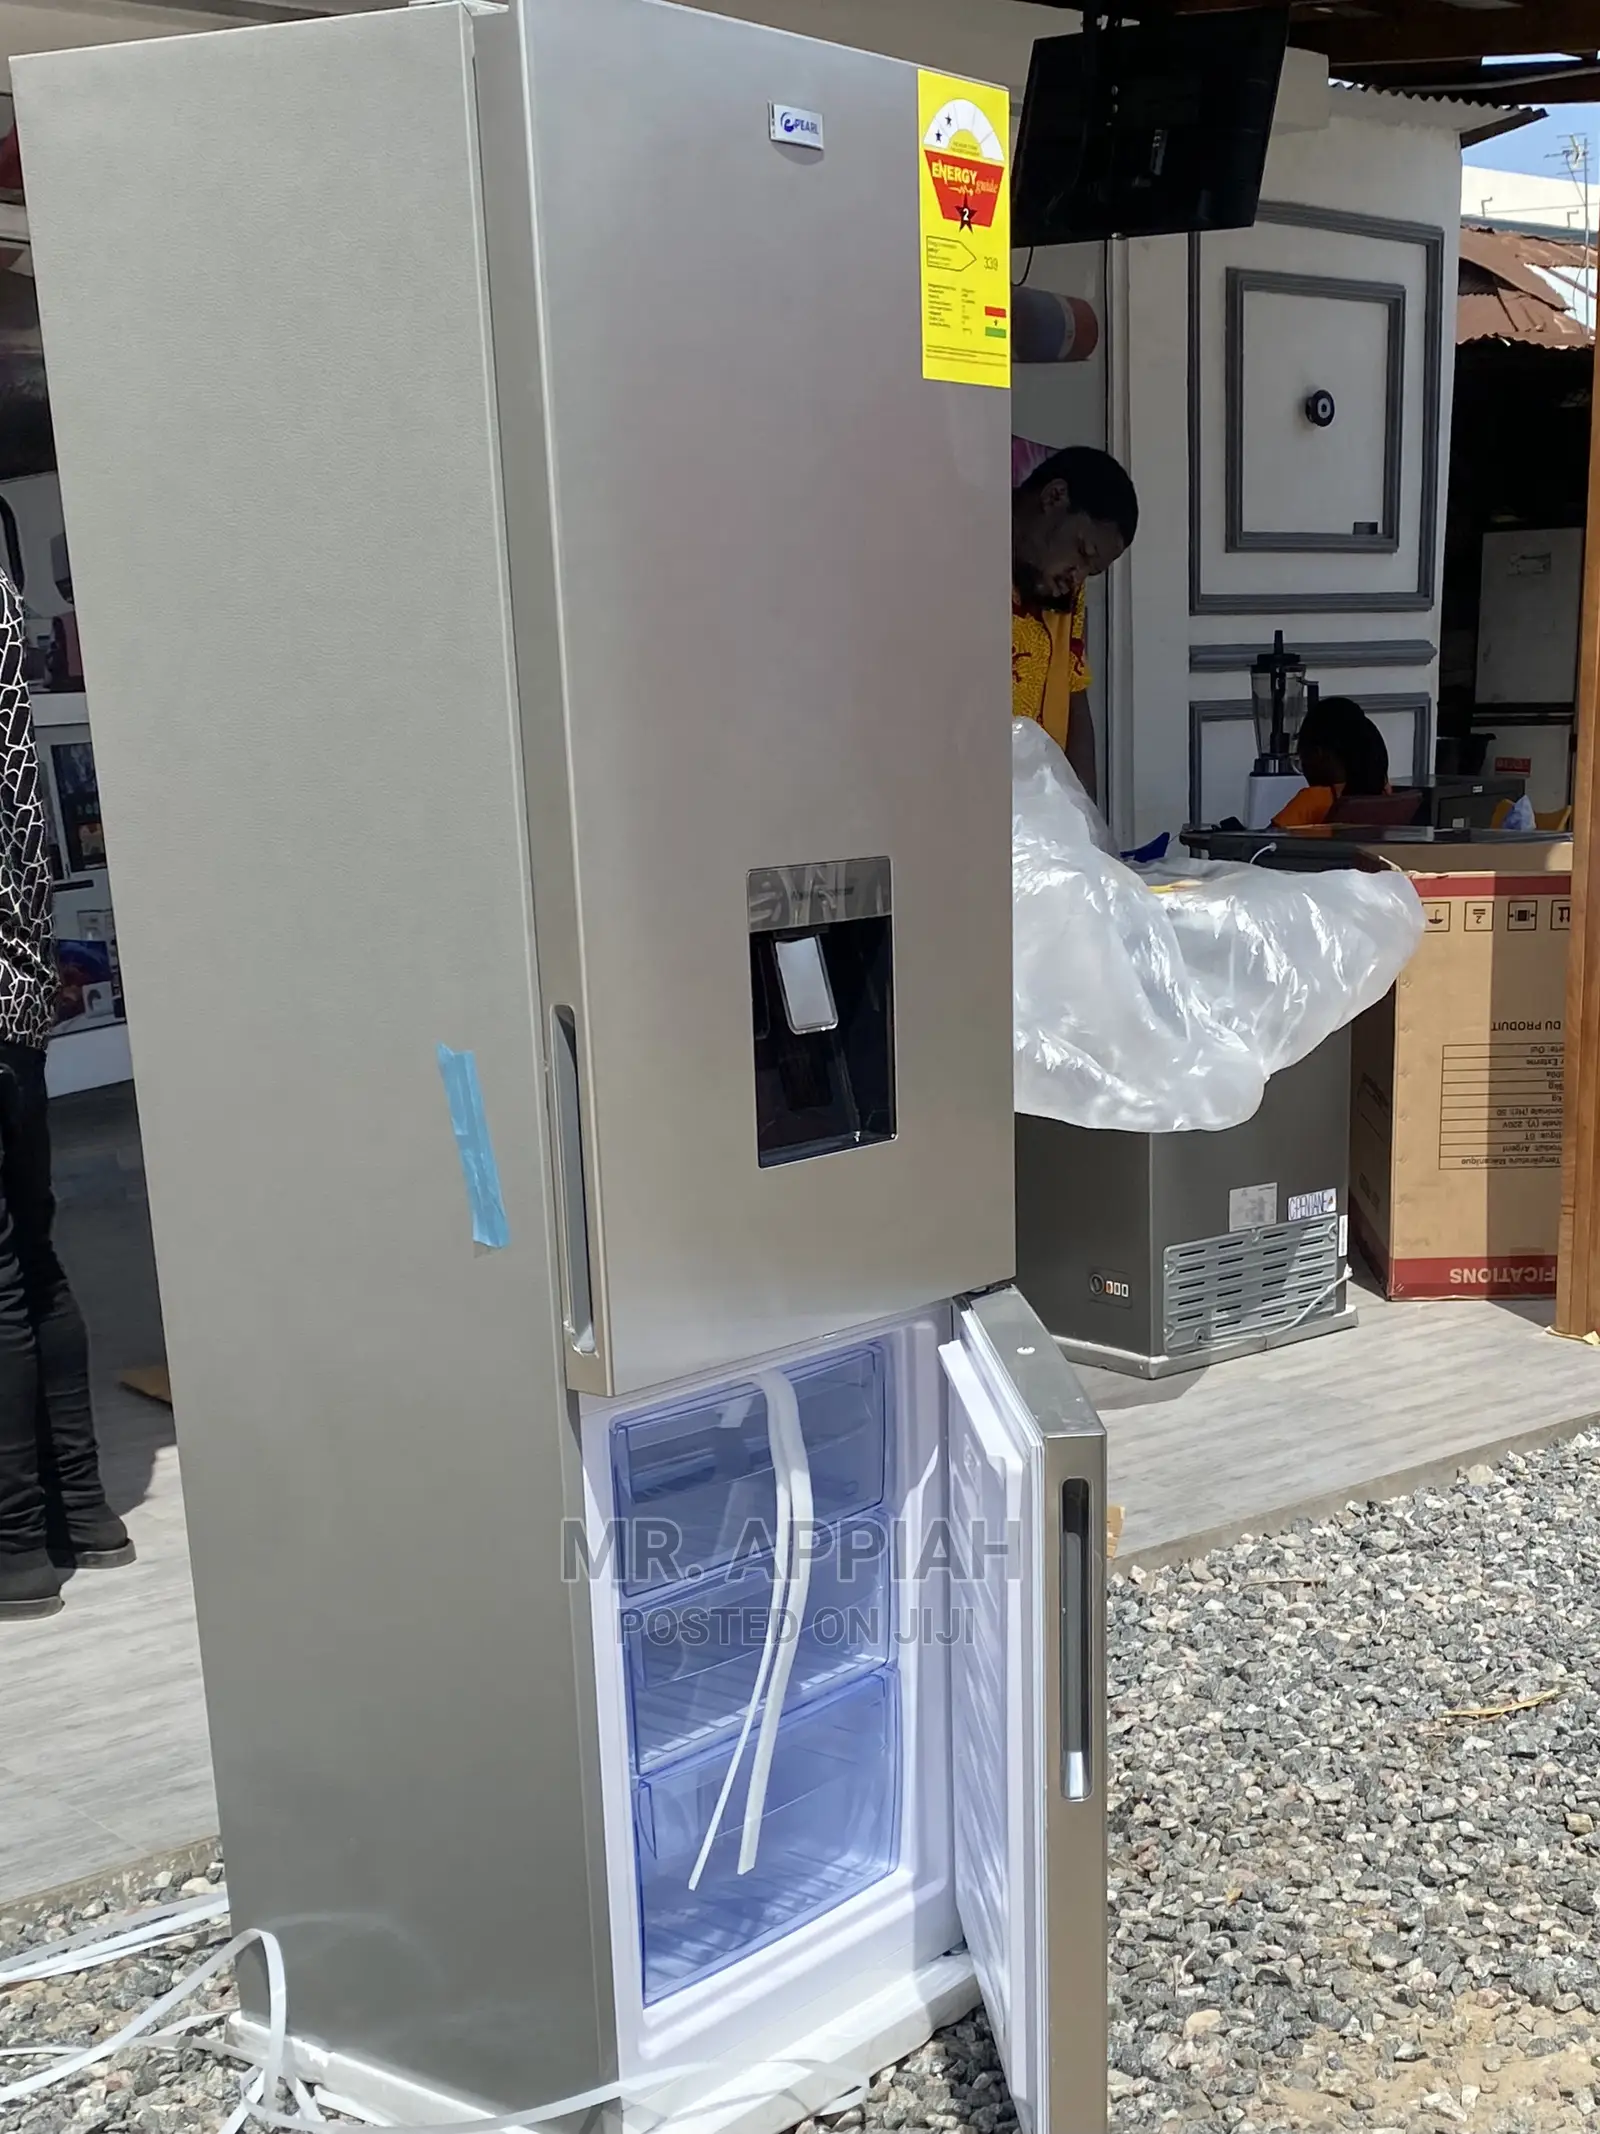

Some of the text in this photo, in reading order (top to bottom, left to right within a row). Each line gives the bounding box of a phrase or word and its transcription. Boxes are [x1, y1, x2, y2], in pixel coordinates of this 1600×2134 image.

[931, 160, 978, 185] ENERGY
[963, 208, 970, 221] 2
[1490, 1020, 1562, 1032] DU PRODUIT
[1449, 1266, 1556, 1284] FICATIONS
